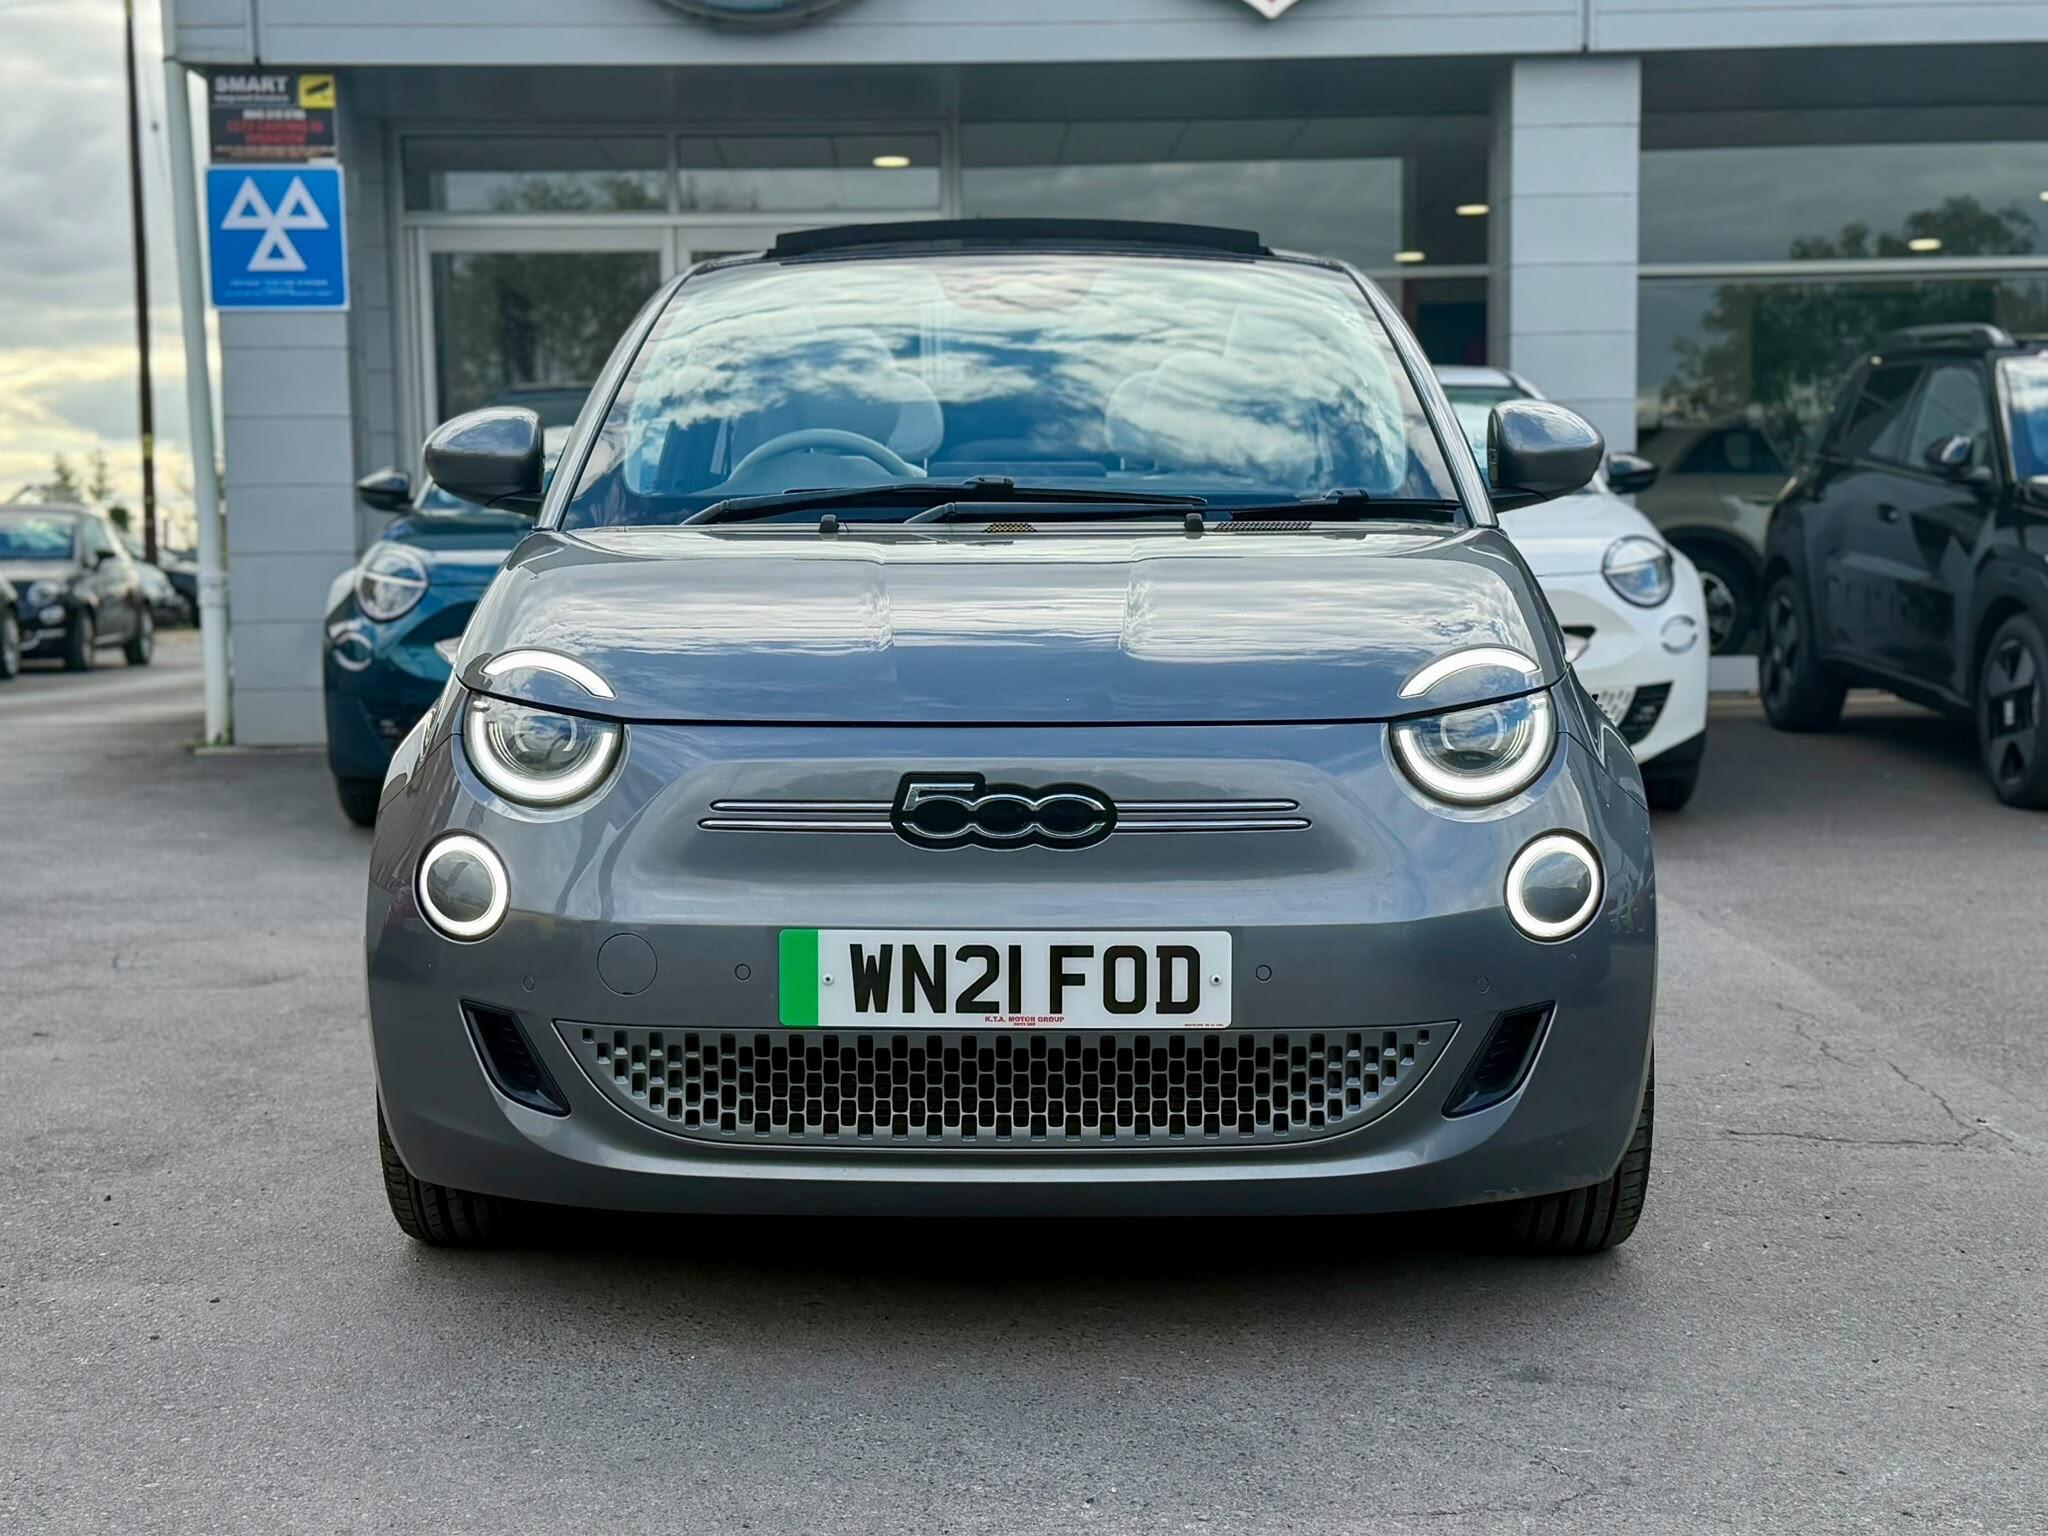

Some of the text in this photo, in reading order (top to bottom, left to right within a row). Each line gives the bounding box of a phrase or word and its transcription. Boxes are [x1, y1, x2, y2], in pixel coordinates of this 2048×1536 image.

[215, 76, 288, 92] SMART
[892, 774, 1115, 849] 500
[849, 943, 1201, 1015] WN21 FOD
